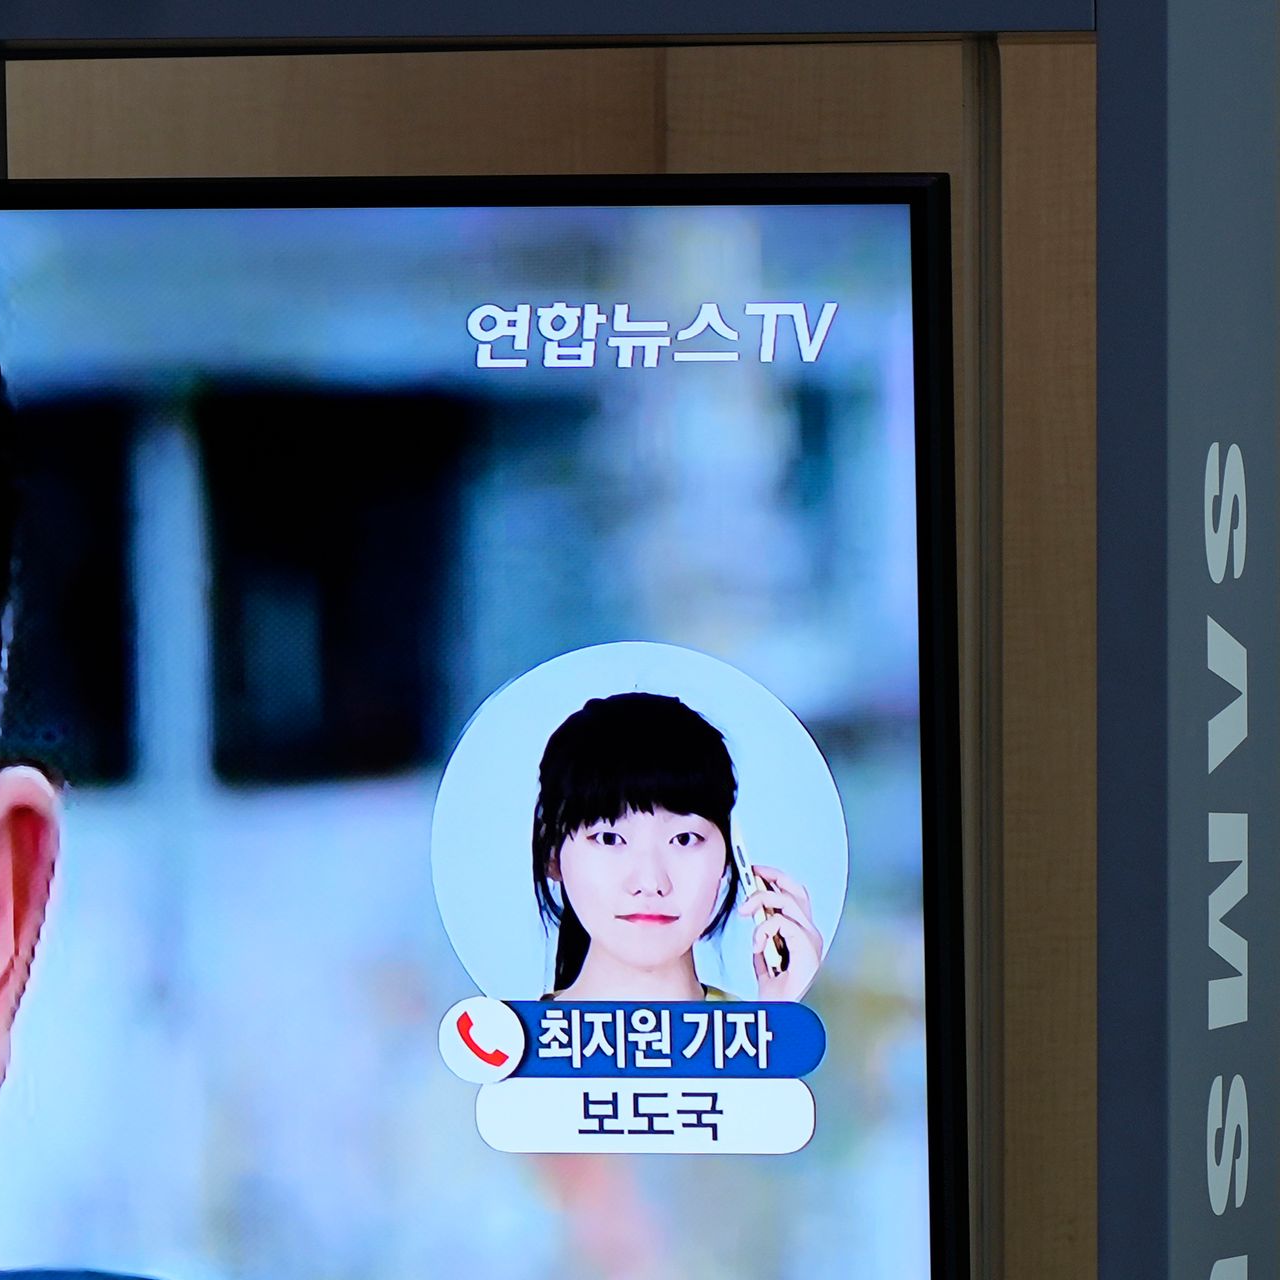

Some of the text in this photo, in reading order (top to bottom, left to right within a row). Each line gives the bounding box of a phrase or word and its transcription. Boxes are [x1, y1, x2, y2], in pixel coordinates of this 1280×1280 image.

[466, 301, 838, 367] 연합뉴스TV
[538, 1009, 773, 1069] 최지원 기자
[578, 1091, 724, 1141] 보도국
